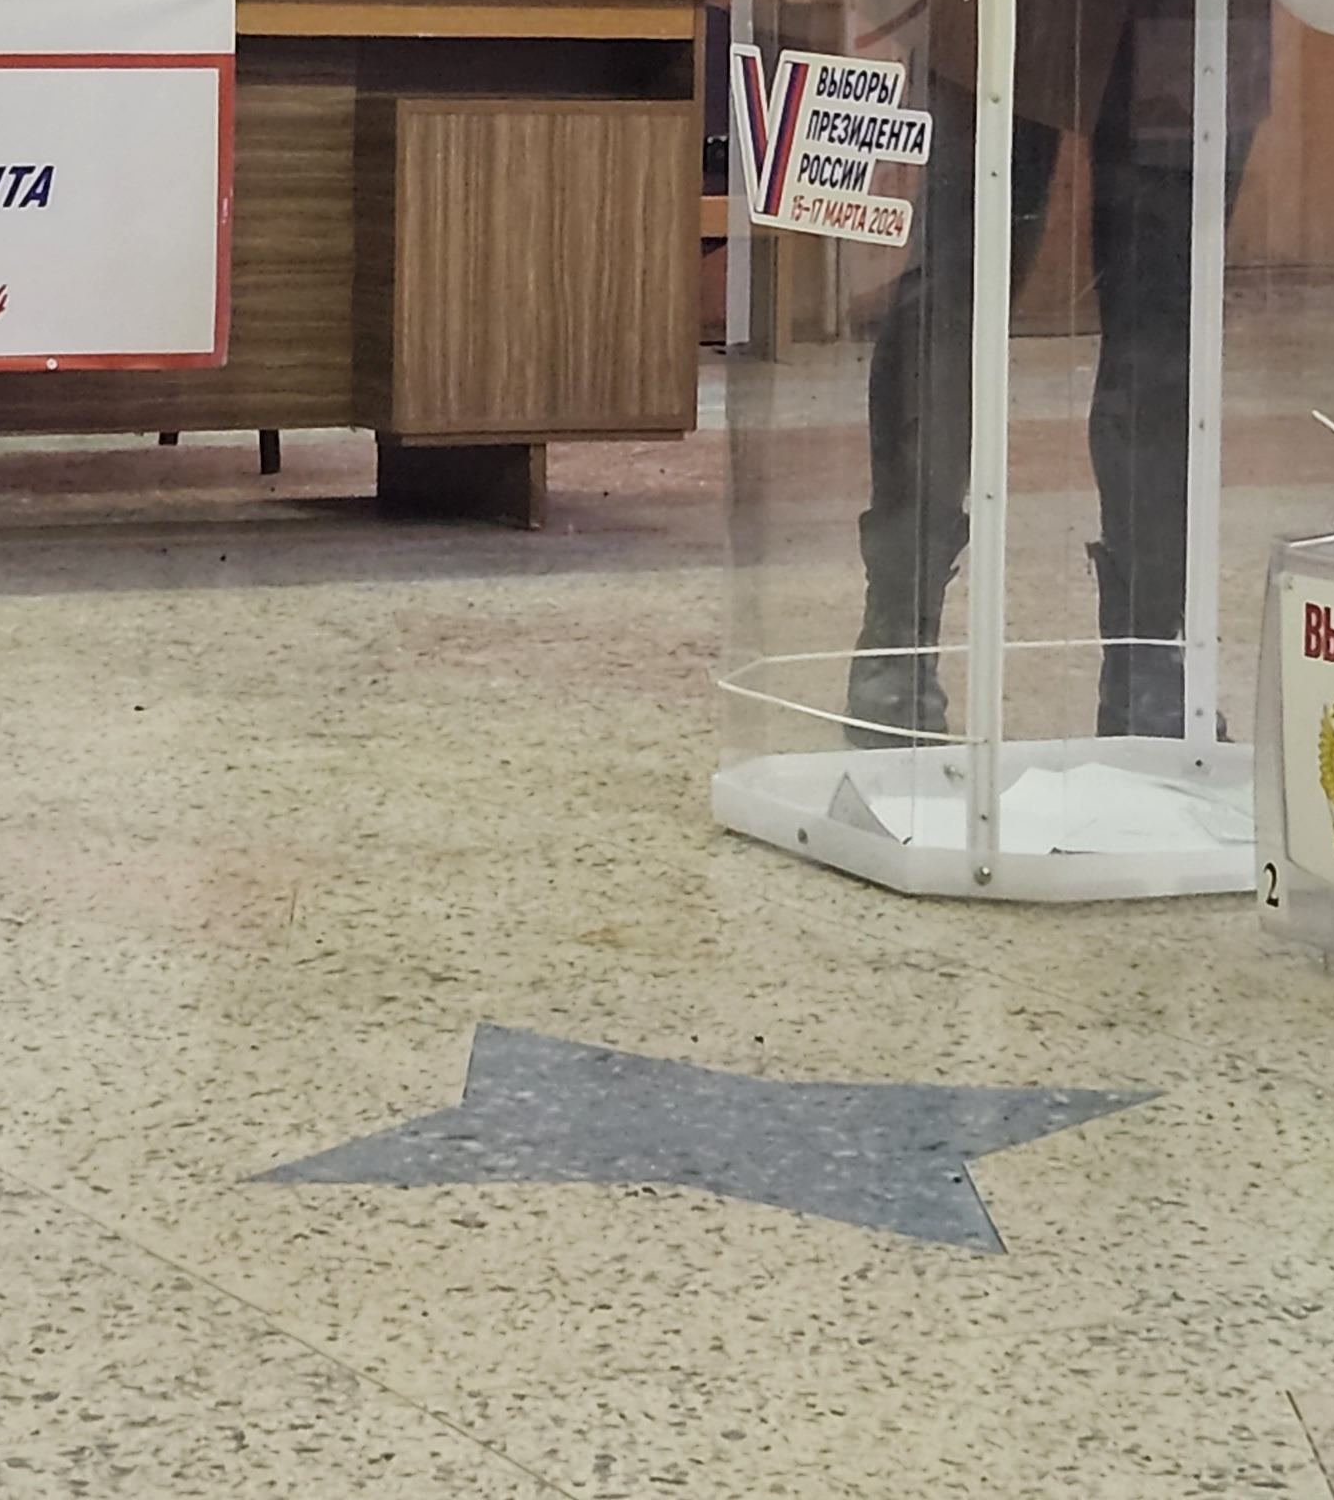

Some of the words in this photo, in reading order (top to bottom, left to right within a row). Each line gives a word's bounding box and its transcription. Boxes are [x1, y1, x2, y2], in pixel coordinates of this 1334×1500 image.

[816, 65, 900, 105] ВЫБОРЫ
[806, 109, 928, 155] ПРЕЗИДЕНТА
[797, 152, 869, 193] РОССИИ
[821, 199, 868, 233] МАРТА
[867, 206, 905, 238] 2024
[1263, 862, 1279, 908] 2
